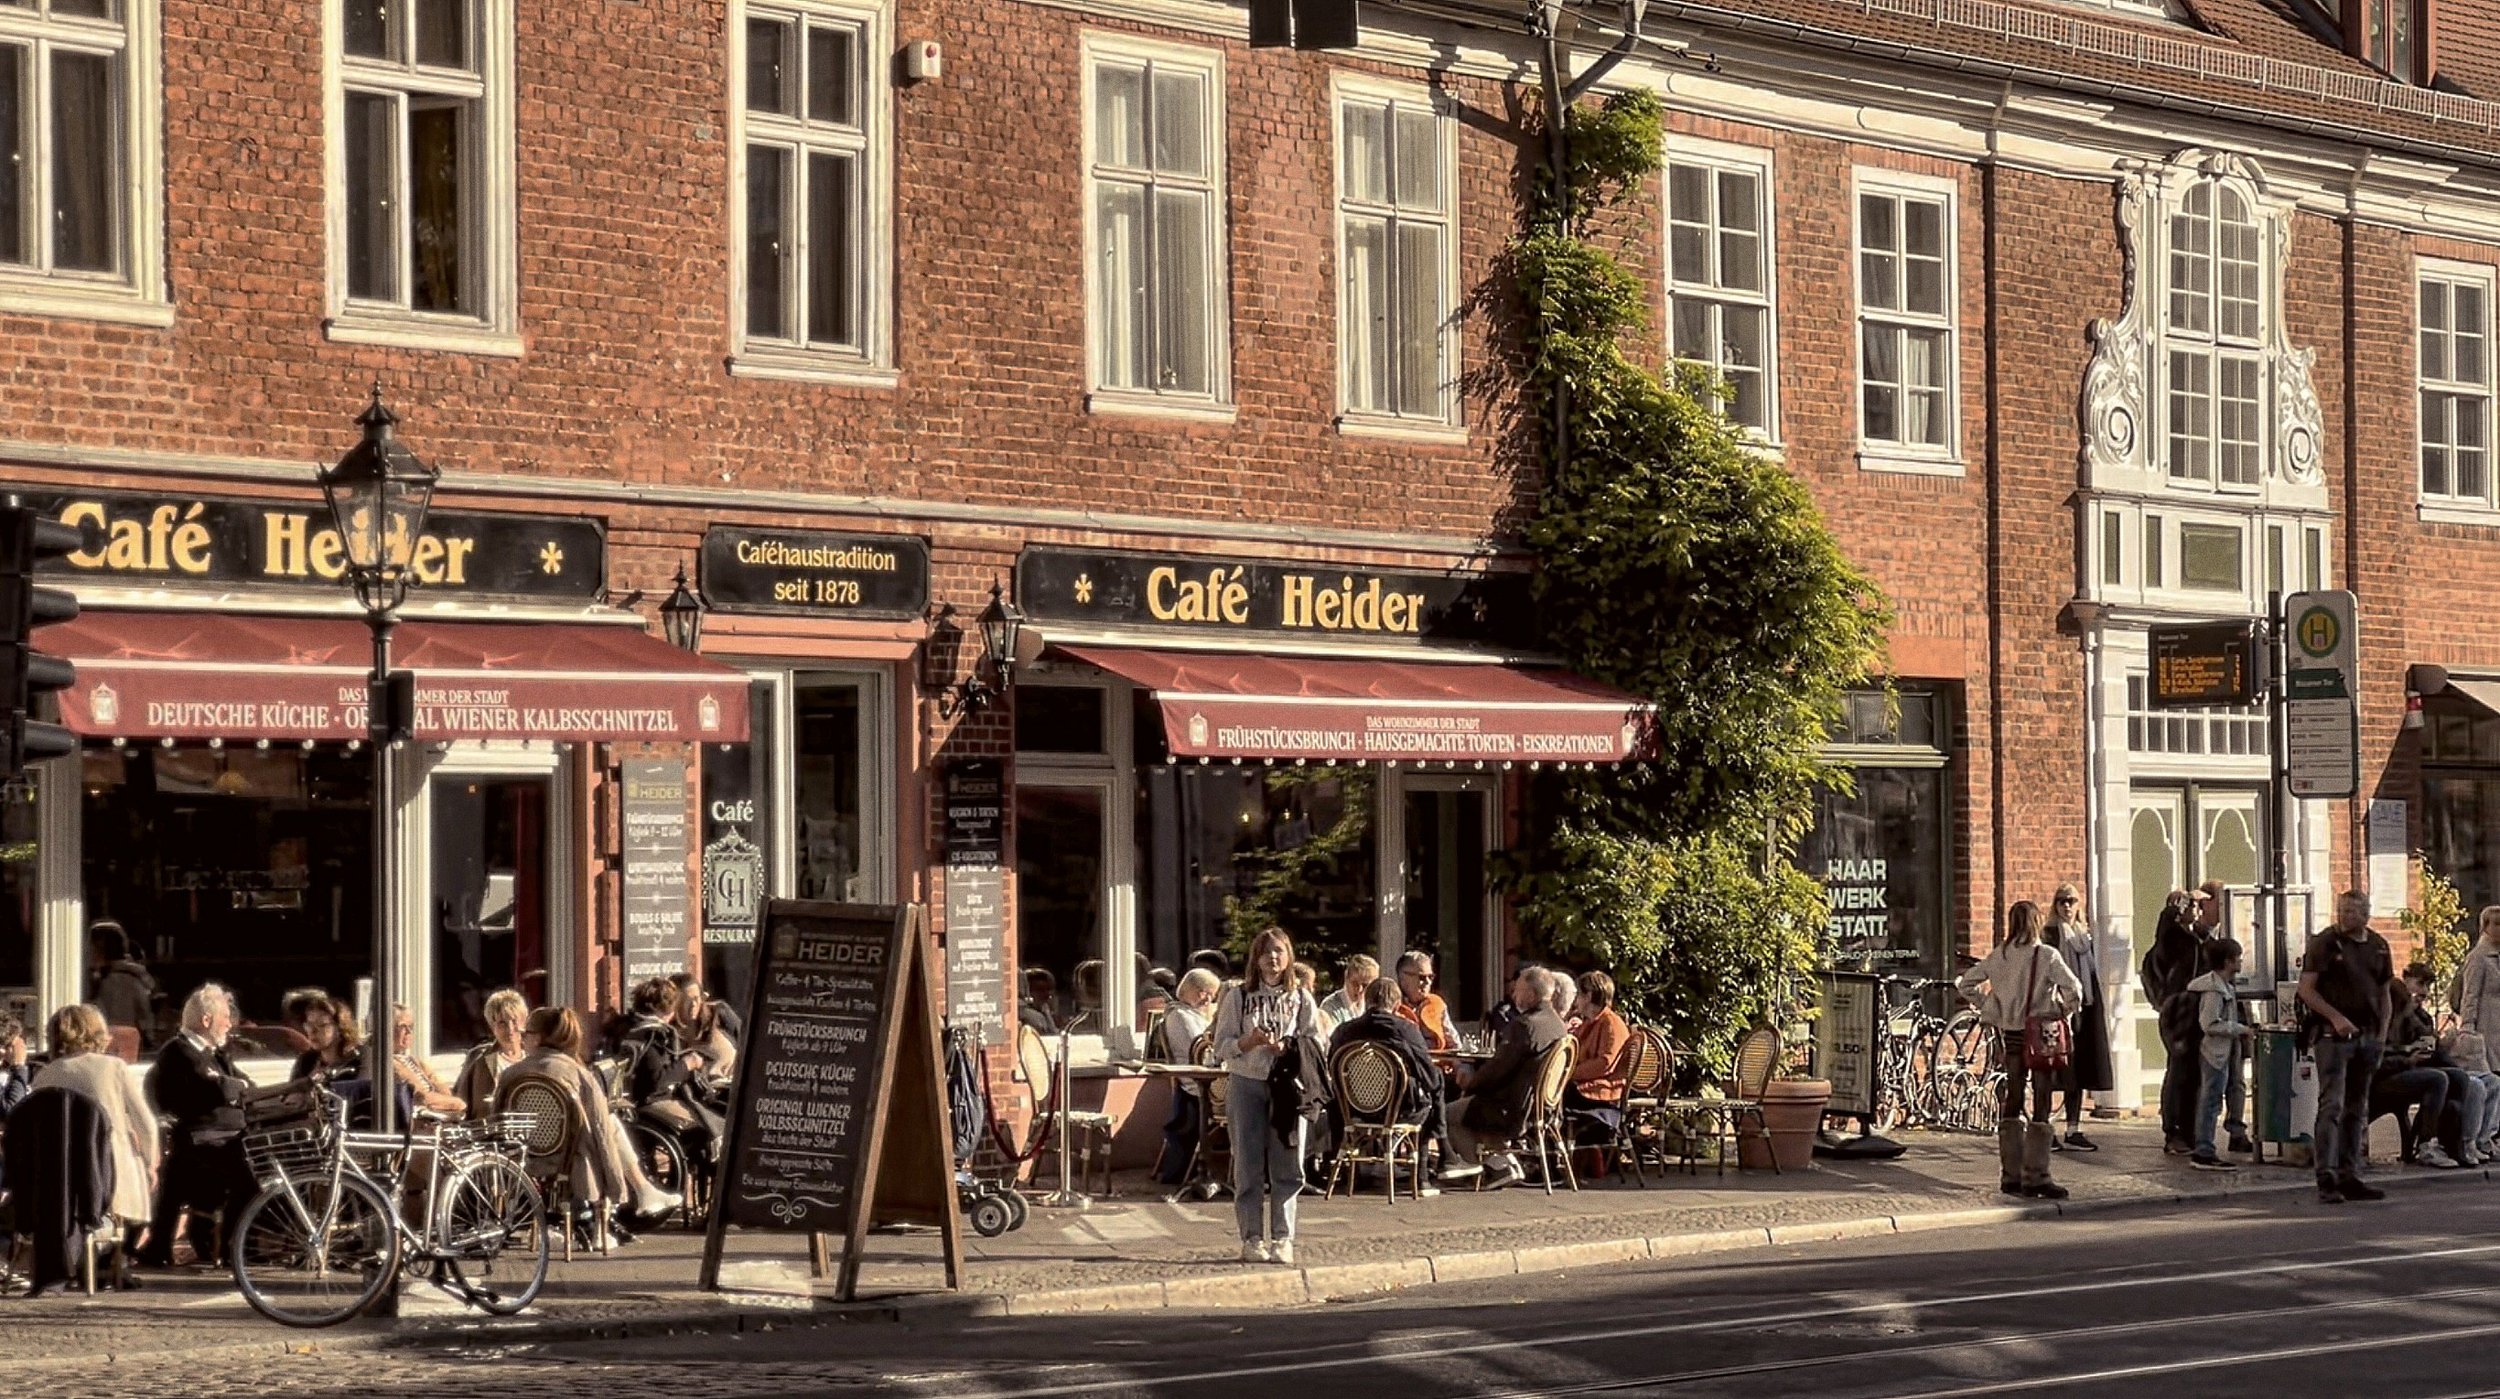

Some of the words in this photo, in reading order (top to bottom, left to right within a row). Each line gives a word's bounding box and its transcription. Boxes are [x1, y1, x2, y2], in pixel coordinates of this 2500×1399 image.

[60, 500, 212, 573] Café
[264, 512, 474, 585] Heider
[737, 540, 896, 571] Caféhaustradition
[774, 578, 809, 601] seit
[815, 580, 860, 604] 1878
[1147, 565, 1250, 625] Café
[1281, 574, 1425, 632] Heider
[339, 687, 362, 702] DAS
[450, 690, 472, 704] DER
[473, 690, 509, 705] STADT
[149, 702, 256, 727] DEUTSCHE
[262, 700, 329, 729] KÜCHE
[442, 708, 519, 732] WIENER
[524, 709, 678, 733] KALBSSCHNITZEL
[1366, 715, 1383, 729] DAS
[1383, 716, 1439, 730] WOHNZIMMER
[1440, 717, 1456, 730] DER
[1457, 718, 1480, 731] STADT
[1218, 725, 1356, 750] FRÜHSTÜCKSBRUNCH
[1365, 731, 1466, 752] HAUSGEMACHTE
[1467, 733, 1515, 753] TORTEN
[1522, 734, 1614, 754] EISKREATIONEN
[640, 786, 683, 799] HEIDER
[711, 799, 754, 822] Café
[1828, 859, 1887, 881] HAAR
[1828, 887, 1888, 909] WERK
[798, 940, 884, 964] HEIDER
[767, 1019, 867, 1042] FRÜHSTÜCKSBRUNCH
[765, 1060, 820, 1079] DEUTSCHE
[820, 1060, 857, 1083] KÜCHE
[755, 1097, 804, 1116] ORIGINAL
[806, 1101, 852, 1120] WIENER
[758, 1114, 846, 1136] KALBSSCHNITZEL
